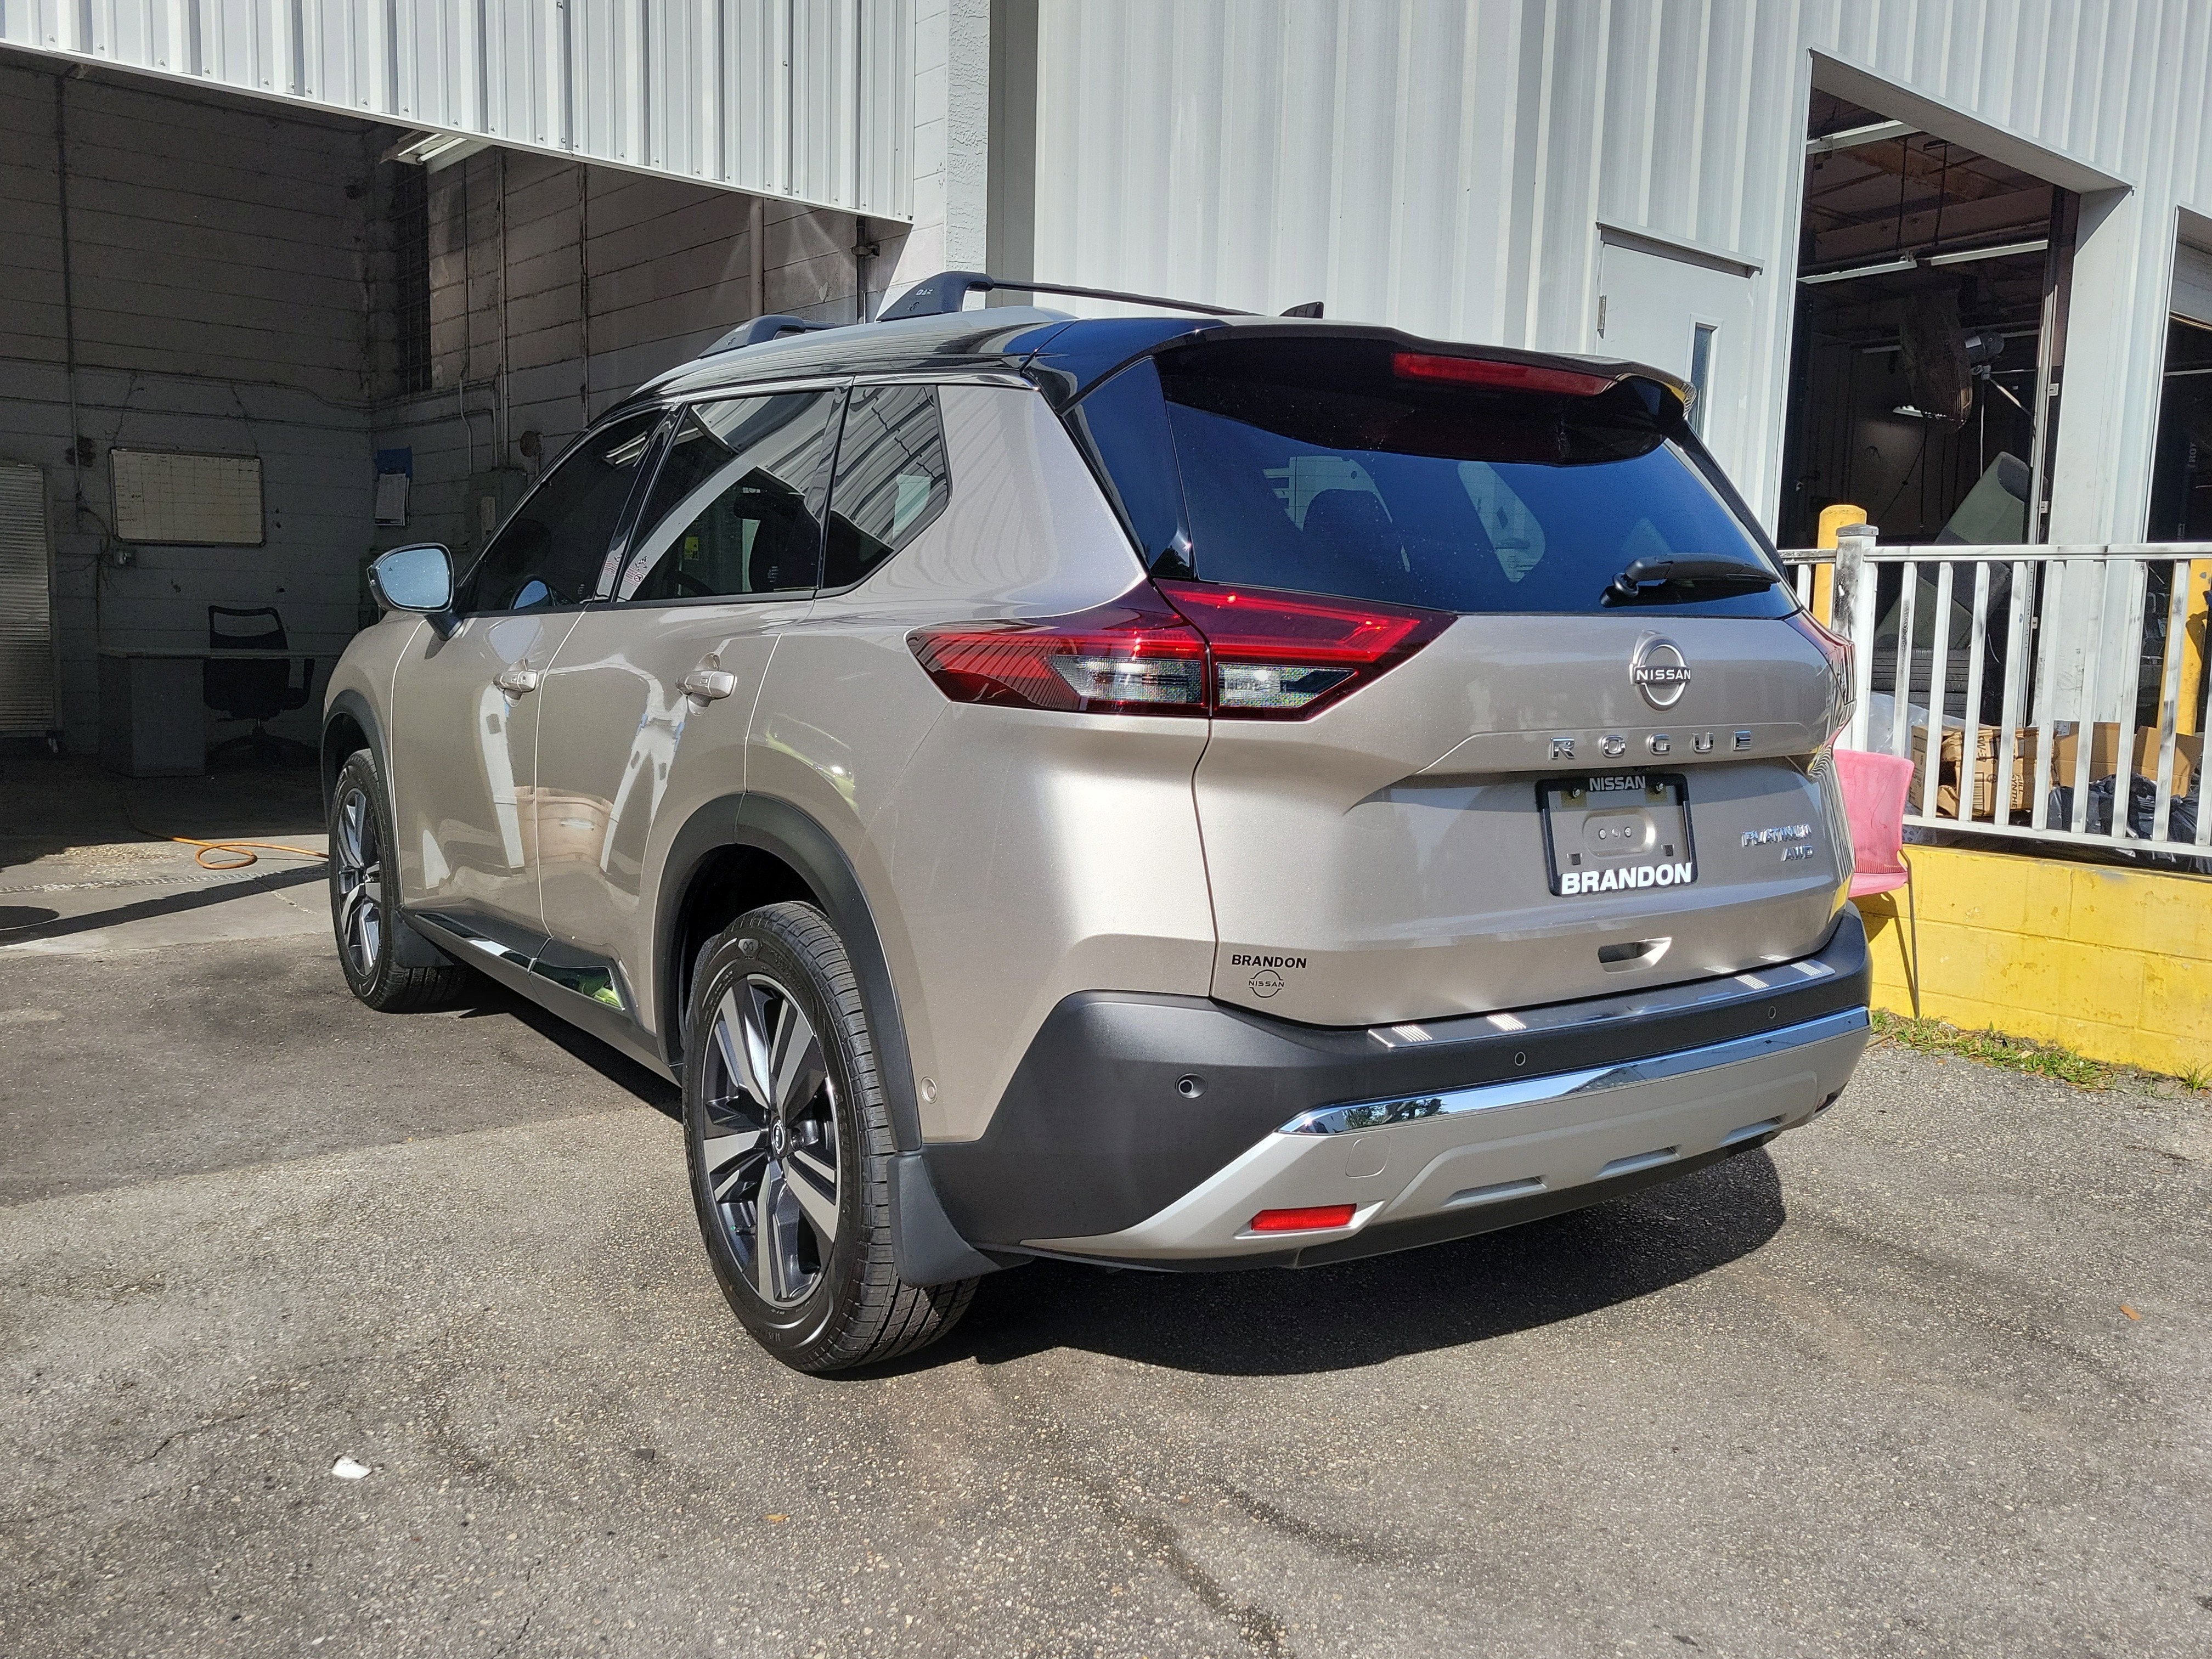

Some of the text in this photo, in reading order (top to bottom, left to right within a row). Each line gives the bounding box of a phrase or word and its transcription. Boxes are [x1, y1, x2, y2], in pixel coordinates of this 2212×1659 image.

[1636, 669, 1691, 680] NISSAN
[1550, 730, 1752, 759] ROGUE
[1589, 775, 1645, 791] NISSAN
[1781, 844, 1813, 861] AWD
[1561, 862, 1692, 895] BRANDON
[1232, 955, 1307, 968] BRANDON
